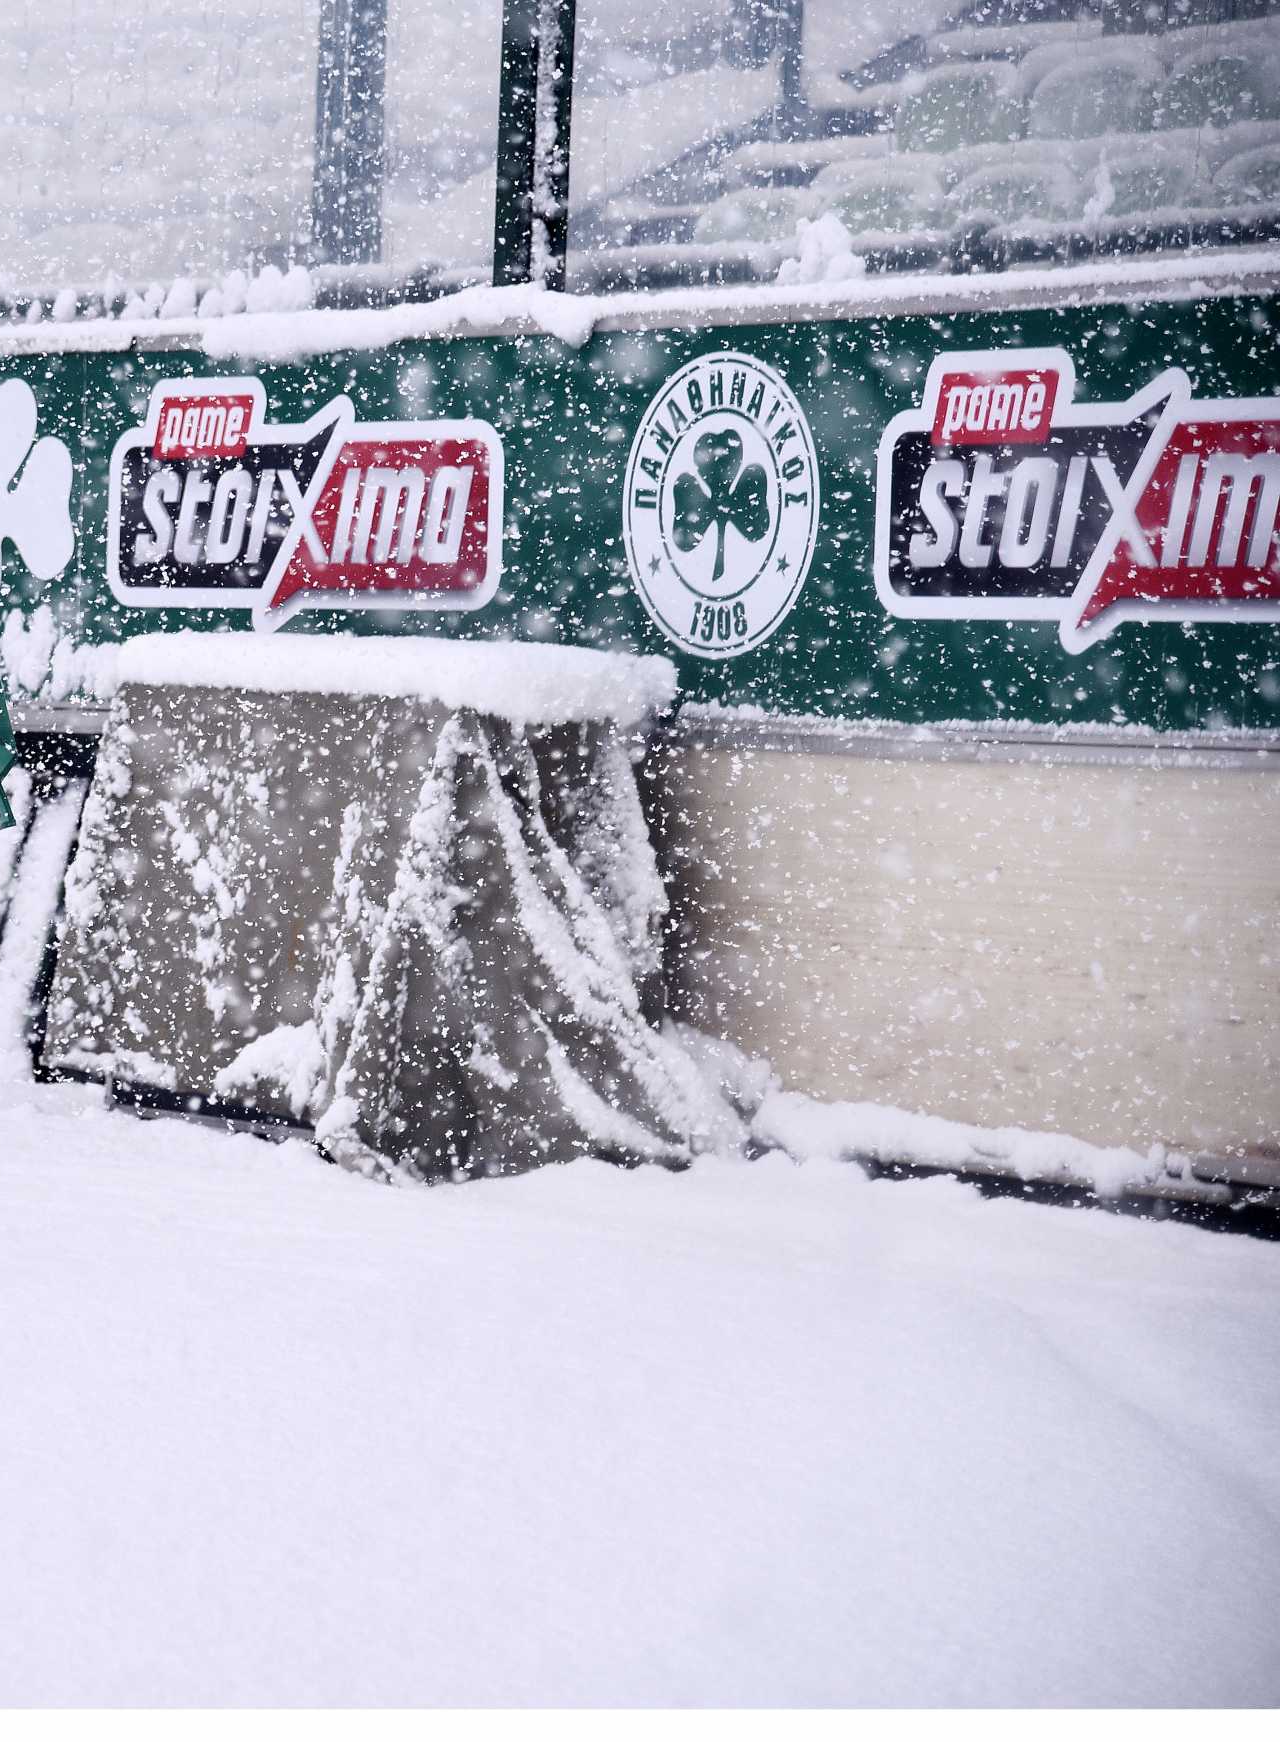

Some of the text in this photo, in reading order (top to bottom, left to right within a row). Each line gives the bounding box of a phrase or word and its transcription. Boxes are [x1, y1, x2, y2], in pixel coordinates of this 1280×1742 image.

[161, 405, 245, 452] pame
[941, 383, 1046, 440] pame
[689, 600, 749, 642] 1908
